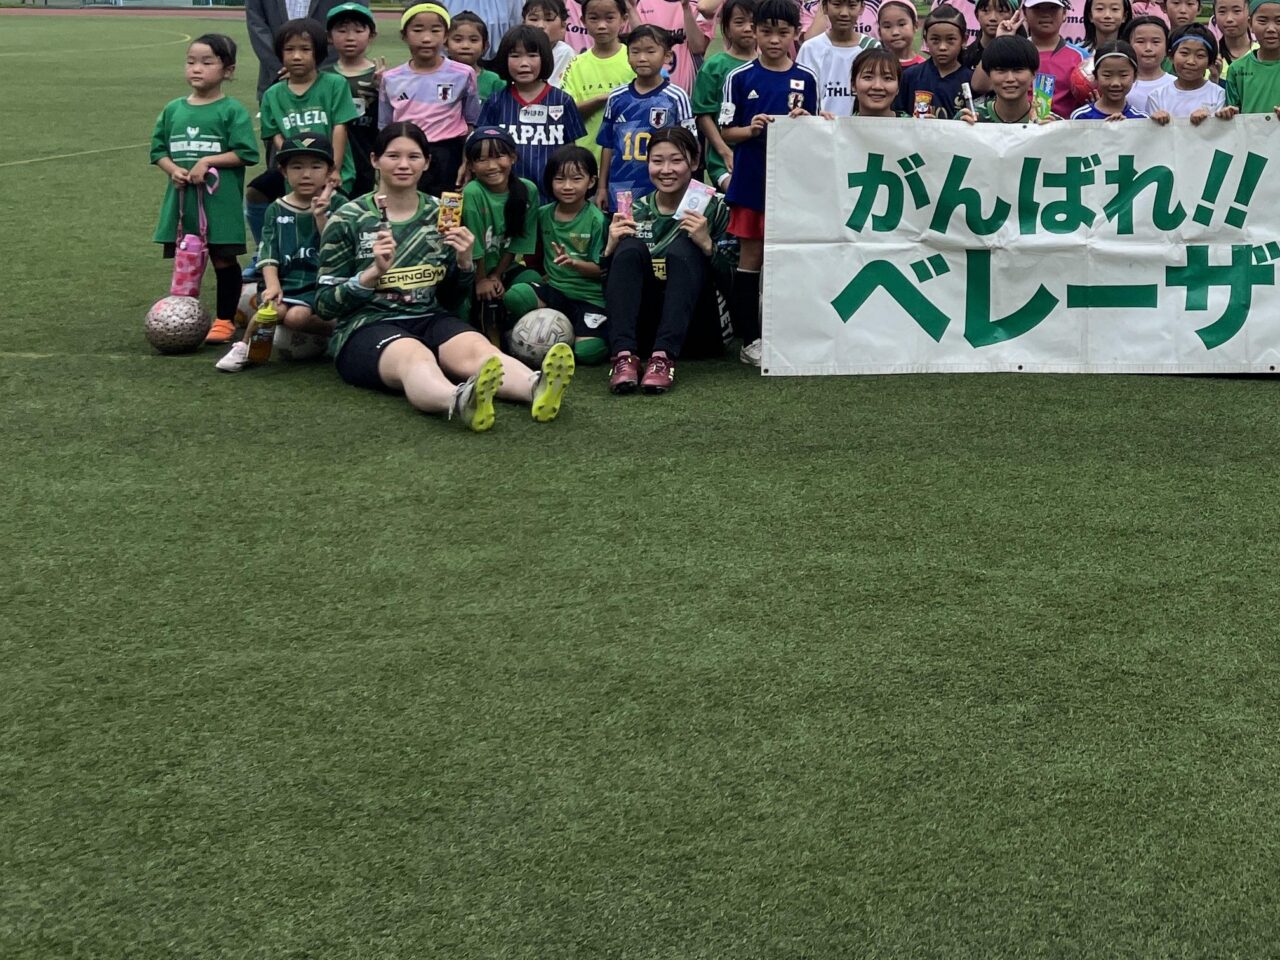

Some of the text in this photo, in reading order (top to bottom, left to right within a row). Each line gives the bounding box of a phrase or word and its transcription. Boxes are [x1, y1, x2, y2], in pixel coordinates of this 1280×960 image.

[282, 110, 328, 130] BELEZA
[499, 124, 565, 146] APAN
[170, 141, 222, 153] BELEZA
[622, 132, 652, 161] 10
[845, 149, 1268, 236] がんばれ!!
